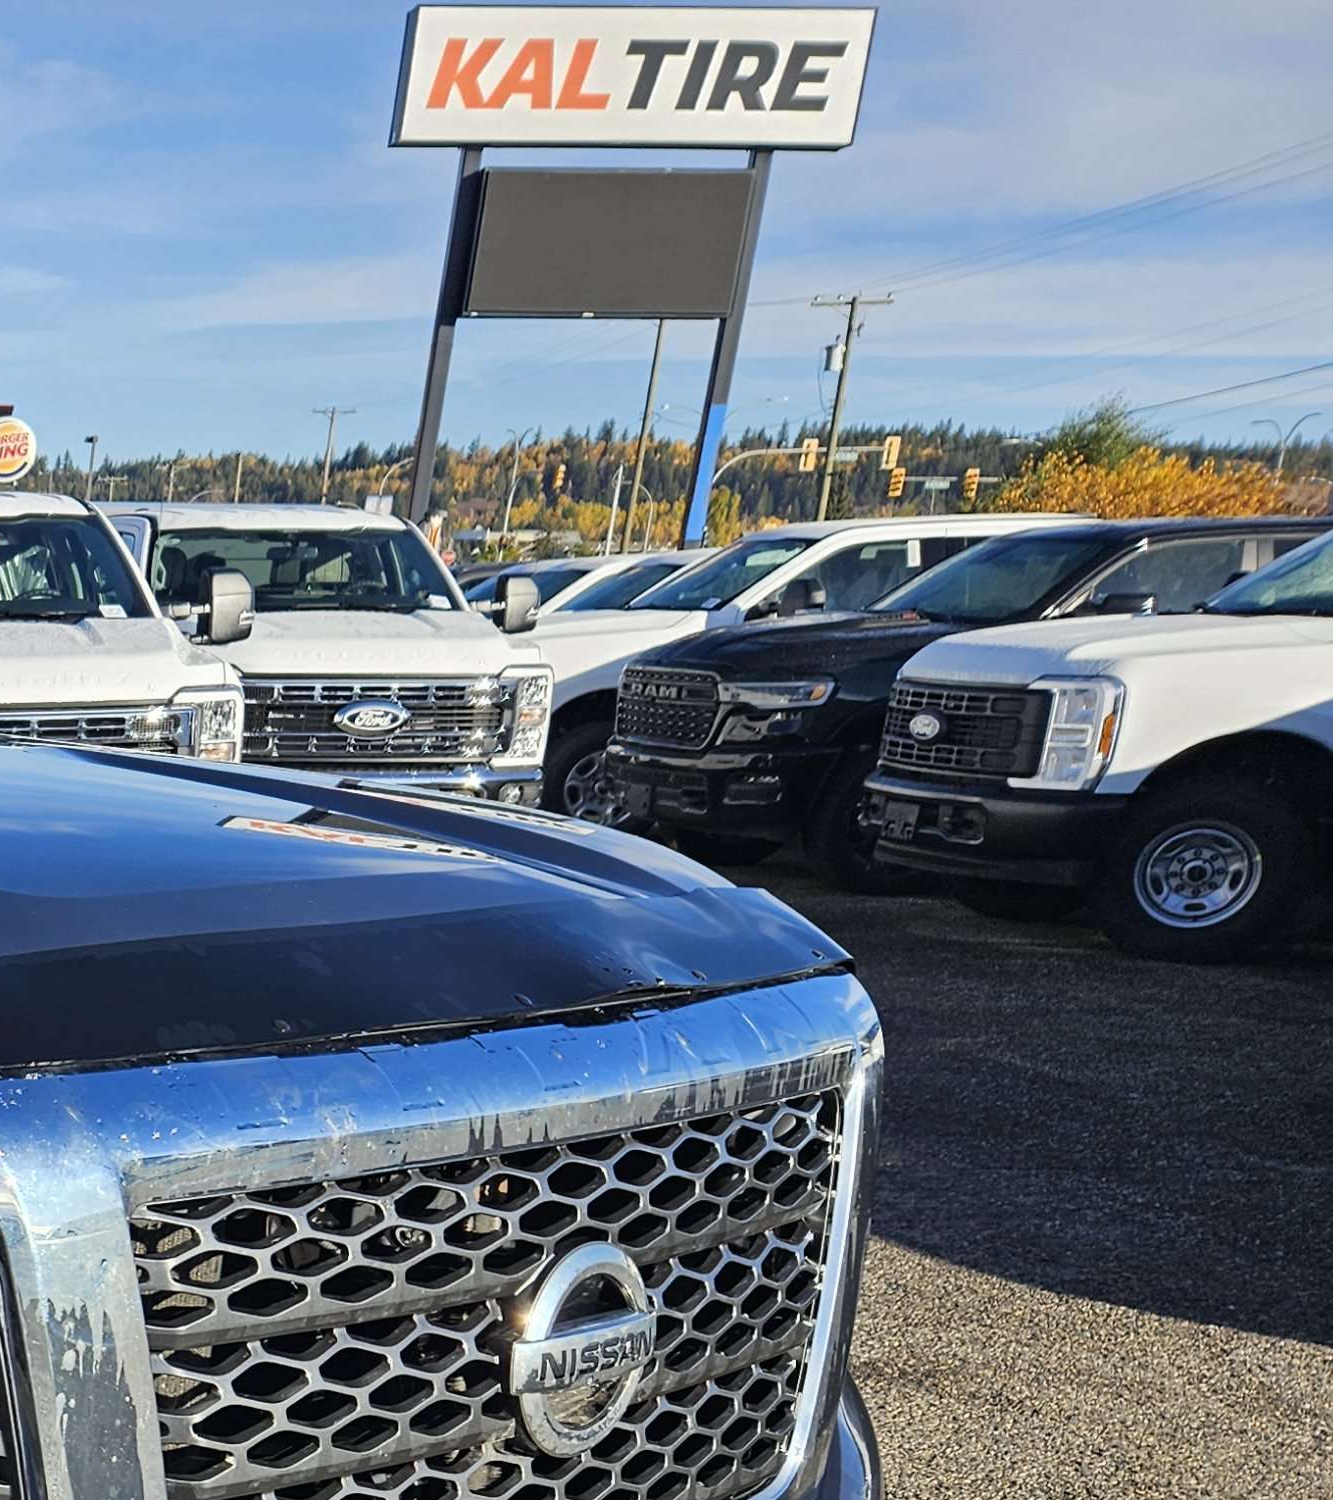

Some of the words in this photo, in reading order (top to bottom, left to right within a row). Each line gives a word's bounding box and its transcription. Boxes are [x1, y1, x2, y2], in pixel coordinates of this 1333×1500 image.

[426, 38, 611, 110] KAL
[626, 40, 849, 112] TIRE
[632, 684, 678, 699] RAM
[540, 1327, 653, 1381] NISSAN
